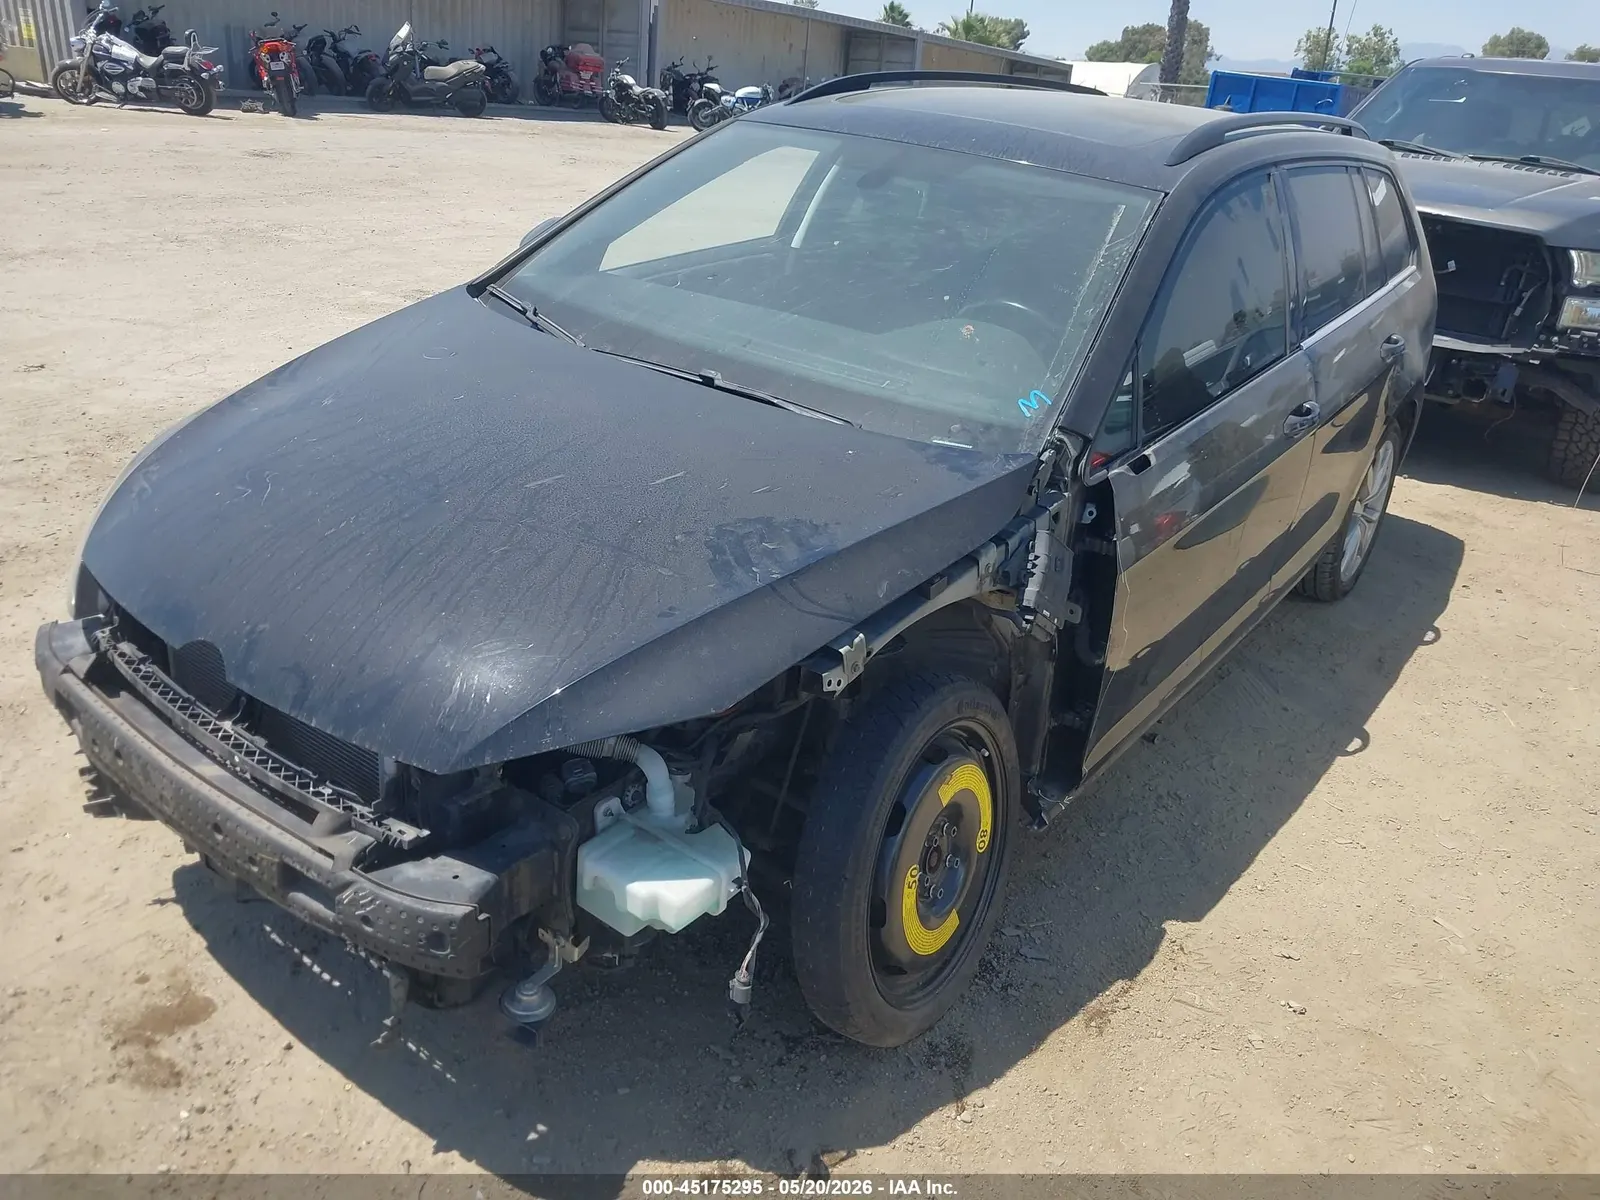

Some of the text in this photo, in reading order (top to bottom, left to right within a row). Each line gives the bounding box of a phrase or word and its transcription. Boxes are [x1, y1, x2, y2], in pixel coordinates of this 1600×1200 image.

[1018, 390, 1052, 417] M
[978, 829, 988, 850] 80
[908, 866, 918, 889] 50
